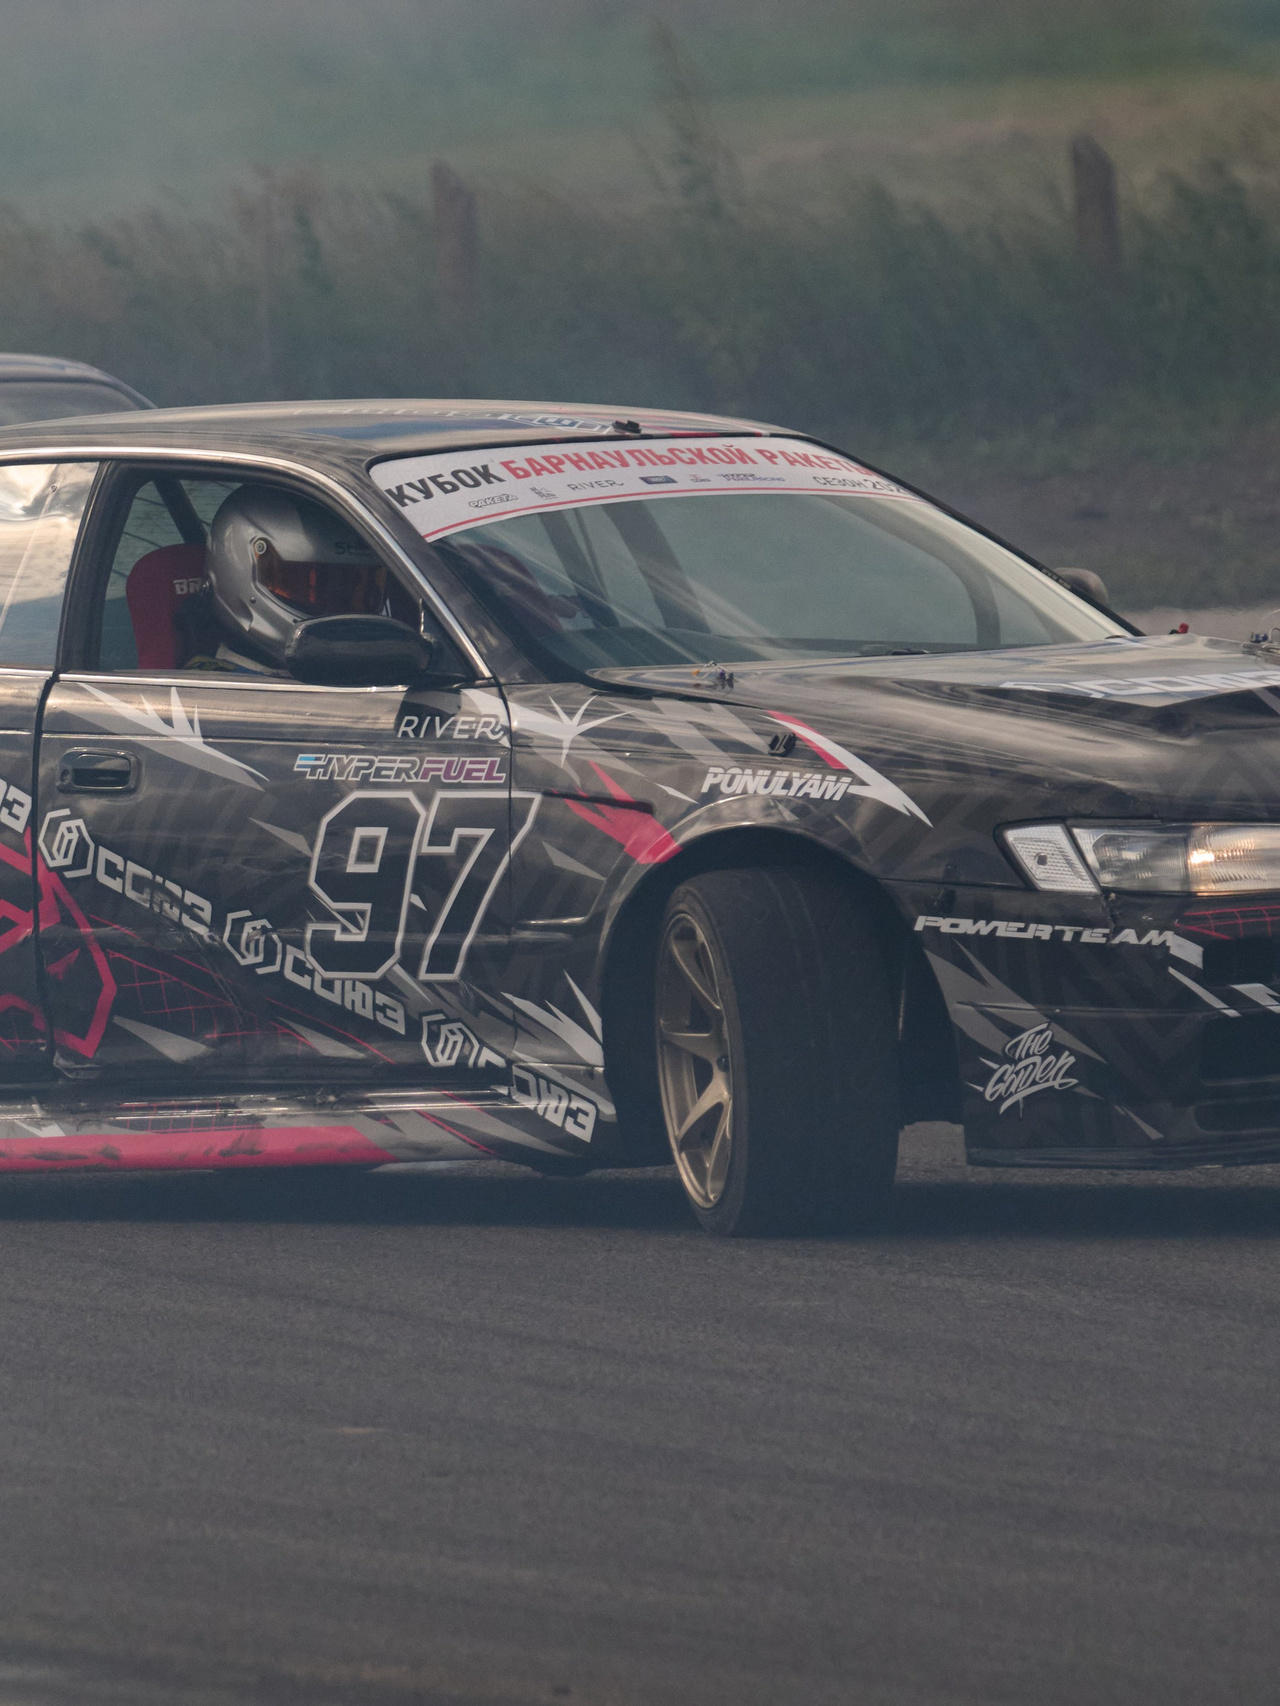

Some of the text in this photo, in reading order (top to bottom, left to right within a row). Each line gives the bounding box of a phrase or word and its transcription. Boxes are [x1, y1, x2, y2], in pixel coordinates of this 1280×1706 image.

[384, 464, 506, 508] КУБОК
[500, 444, 756, 480] БАРНАУЛЬСКОЙ
[567, 479, 625, 493] RIVER
[813, 476, 868, 489] СЕЗОН
[397, 715, 504, 740] RIVER
[701, 767, 853, 801] PONULYAM
[305, 790, 542, 980] 97
